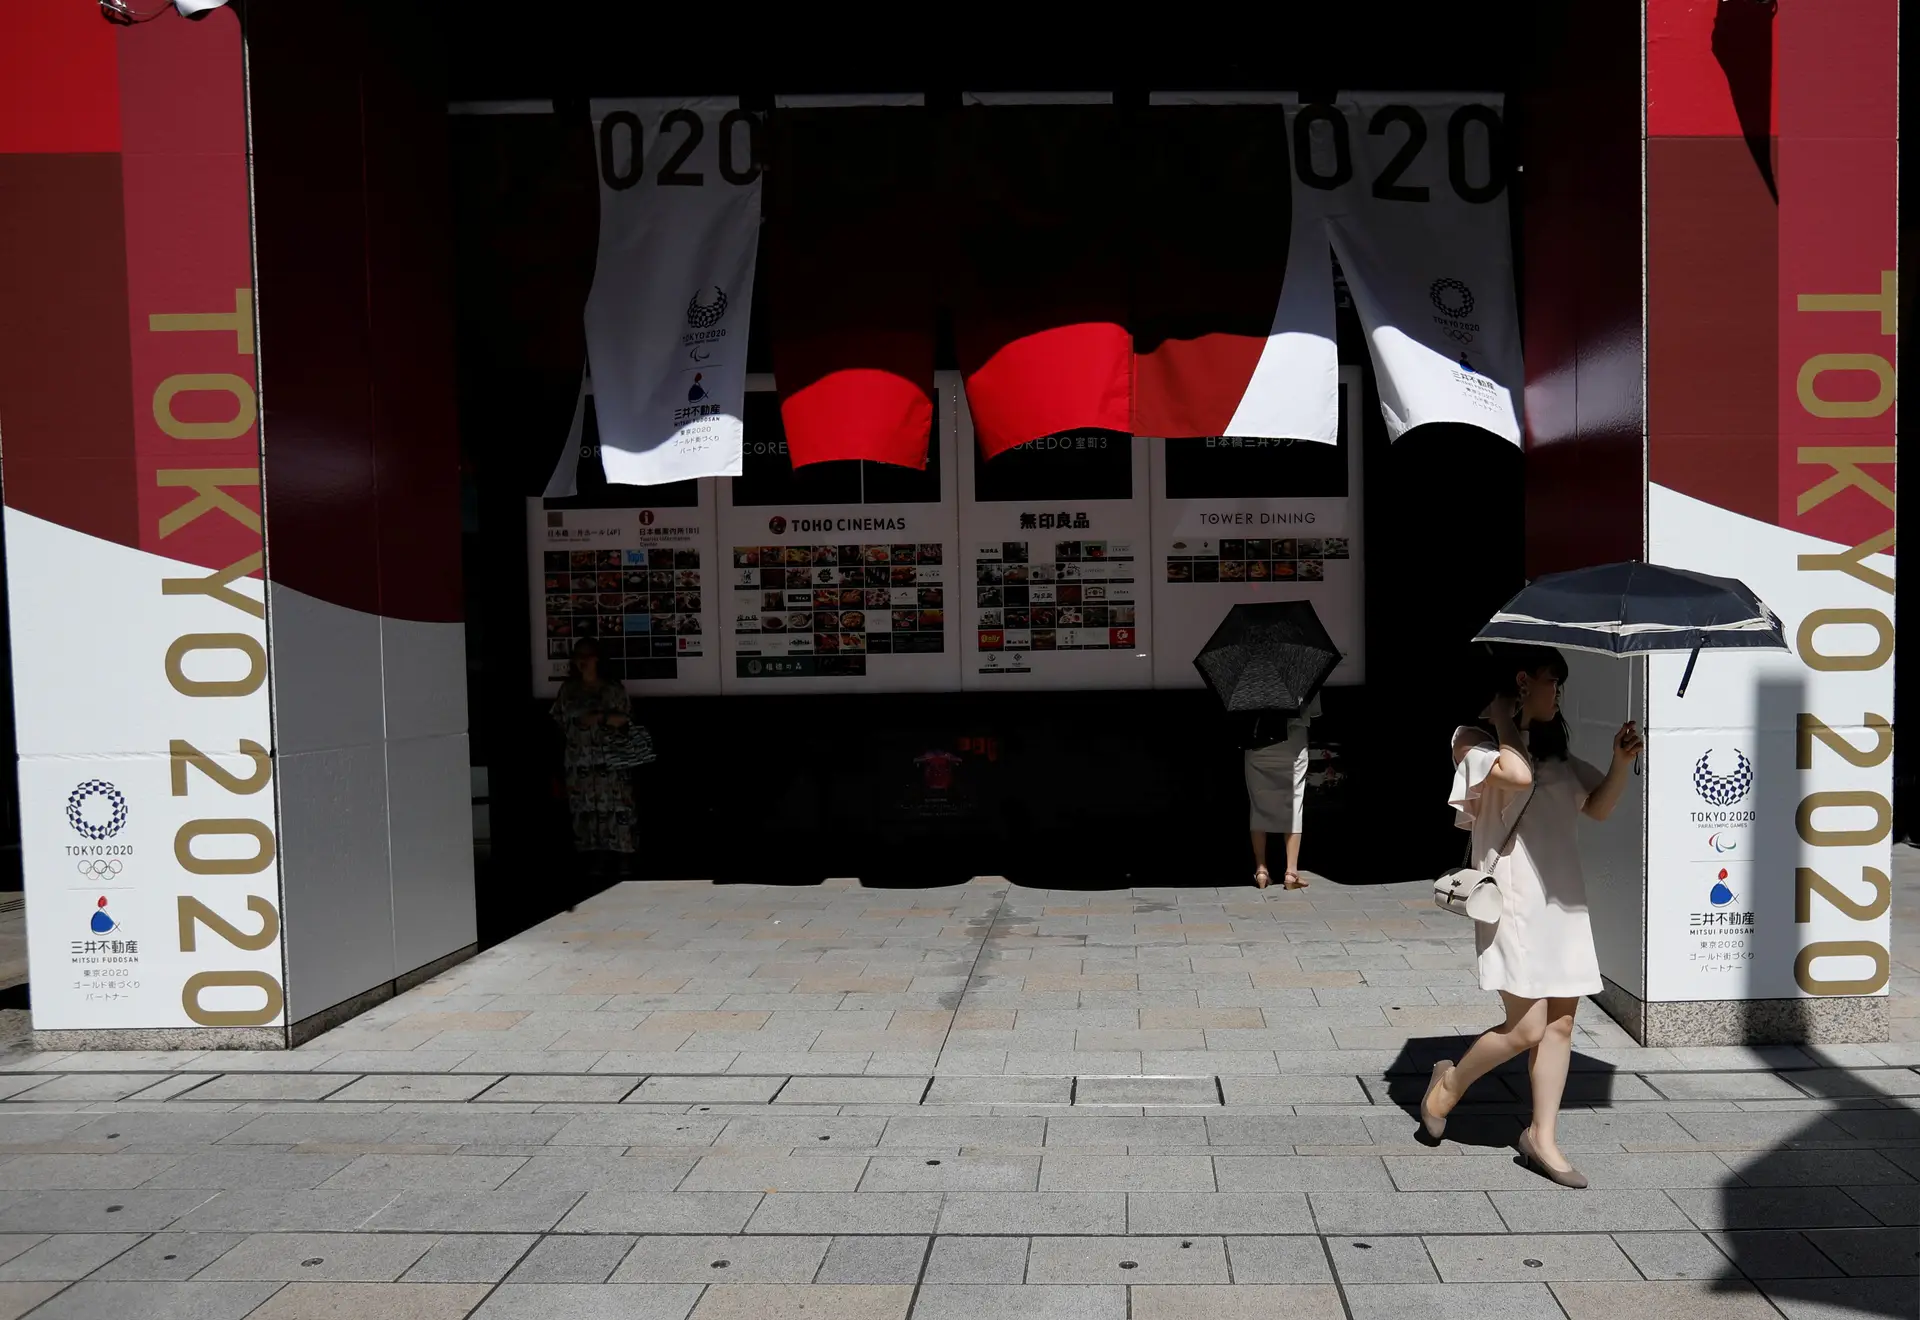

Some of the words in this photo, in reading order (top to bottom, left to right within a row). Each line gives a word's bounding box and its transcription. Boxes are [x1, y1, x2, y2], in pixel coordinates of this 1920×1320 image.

[674, 403, 721, 420] 三井不動産
[1796, 270, 1897, 672] TOKYO
[149, 288, 267, 698] TOKYO
[1019, 511, 1090, 529] 無印良品
[1200, 513, 1254, 525] TOWER
[1260, 512, 1316, 524] DINING
[791, 519, 833, 532] TOHO
[836, 518, 906, 531] CINEMAS
[1690, 812, 1727, 823] TOKYO
[1729, 811, 1756, 822] 2020
[65, 845, 103, 857] TOKYO
[106, 845, 134, 856] 2020
[1793, 712, 1893, 996] 2020
[169, 738, 284, 1027] 2020
[1689, 911, 1755, 927] 三井不動産
[1690, 928, 1716, 936] MITSUI
[1718, 927, 1755, 935] FUDOSAN
[71, 940, 139, 954] 三井不動産
[1699, 940, 1744, 950] 東京2020
[102, 956, 139, 964] FUDOSAN
[1689, 951, 1755, 961] ゴールド街づくり
[83, 968, 129, 977] 東京2020
[1700, 963, 1743, 973] パートナー
[73, 980, 141, 990] ゴールド街づくり
[86, 992, 129, 1002] パートナー
